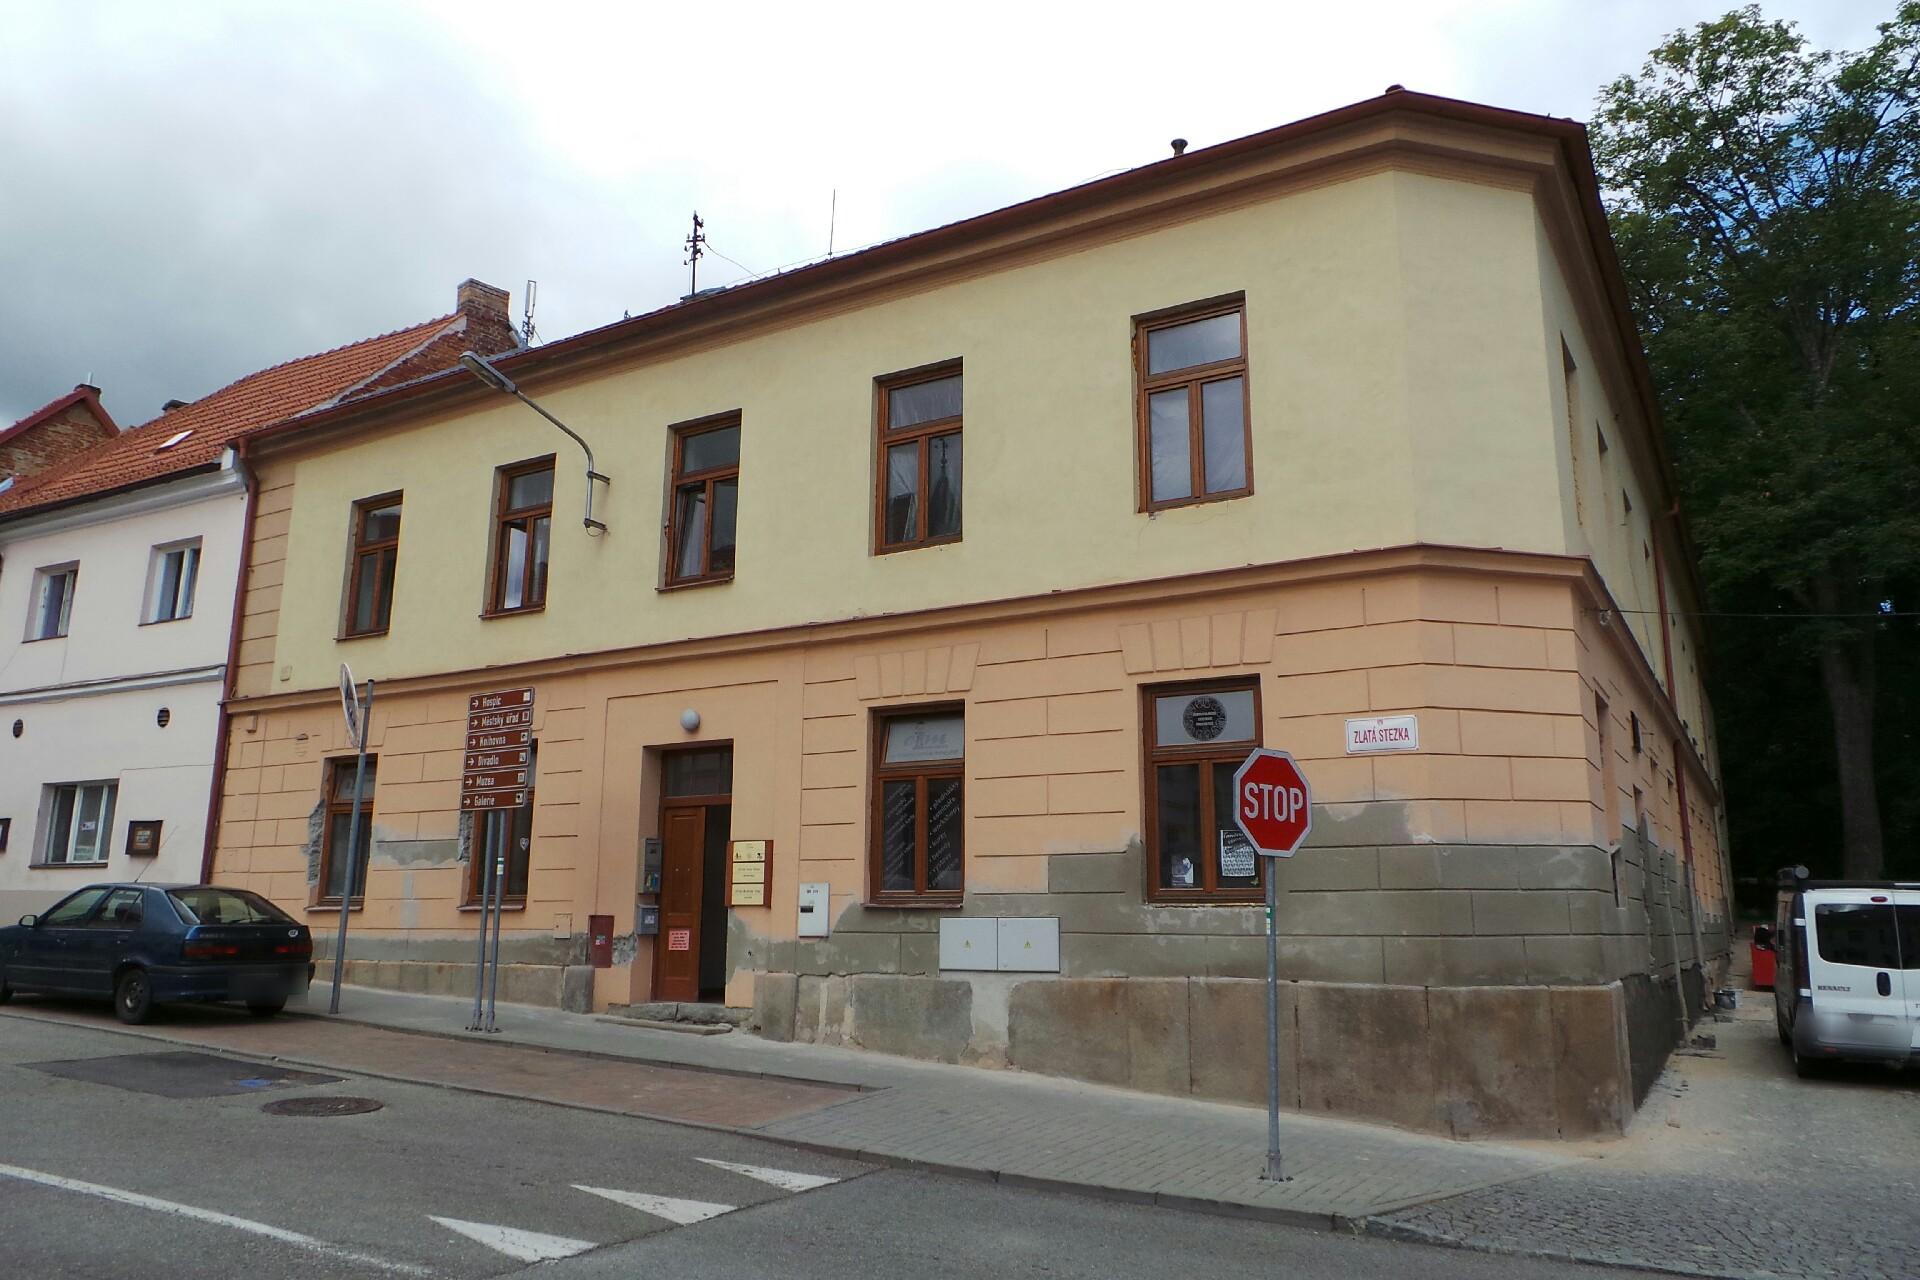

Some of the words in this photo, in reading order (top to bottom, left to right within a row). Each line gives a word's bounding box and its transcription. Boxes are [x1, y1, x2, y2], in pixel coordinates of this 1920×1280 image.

[482, 695, 502, 709] Hospic
[482, 713, 504, 727] Městský
[506, 712, 519, 724] úřad
[479, 735, 506, 747] Knihovna
[1353, 727, 1377, 744] ZLATÁ
[1379, 727, 1410, 743] STEZKA
[478, 755, 499, 767] Divadlo
[476, 776, 495, 787] Muzea
[474, 795, 495, 807] Galerie
[1244, 781, 1304, 824] STOP
